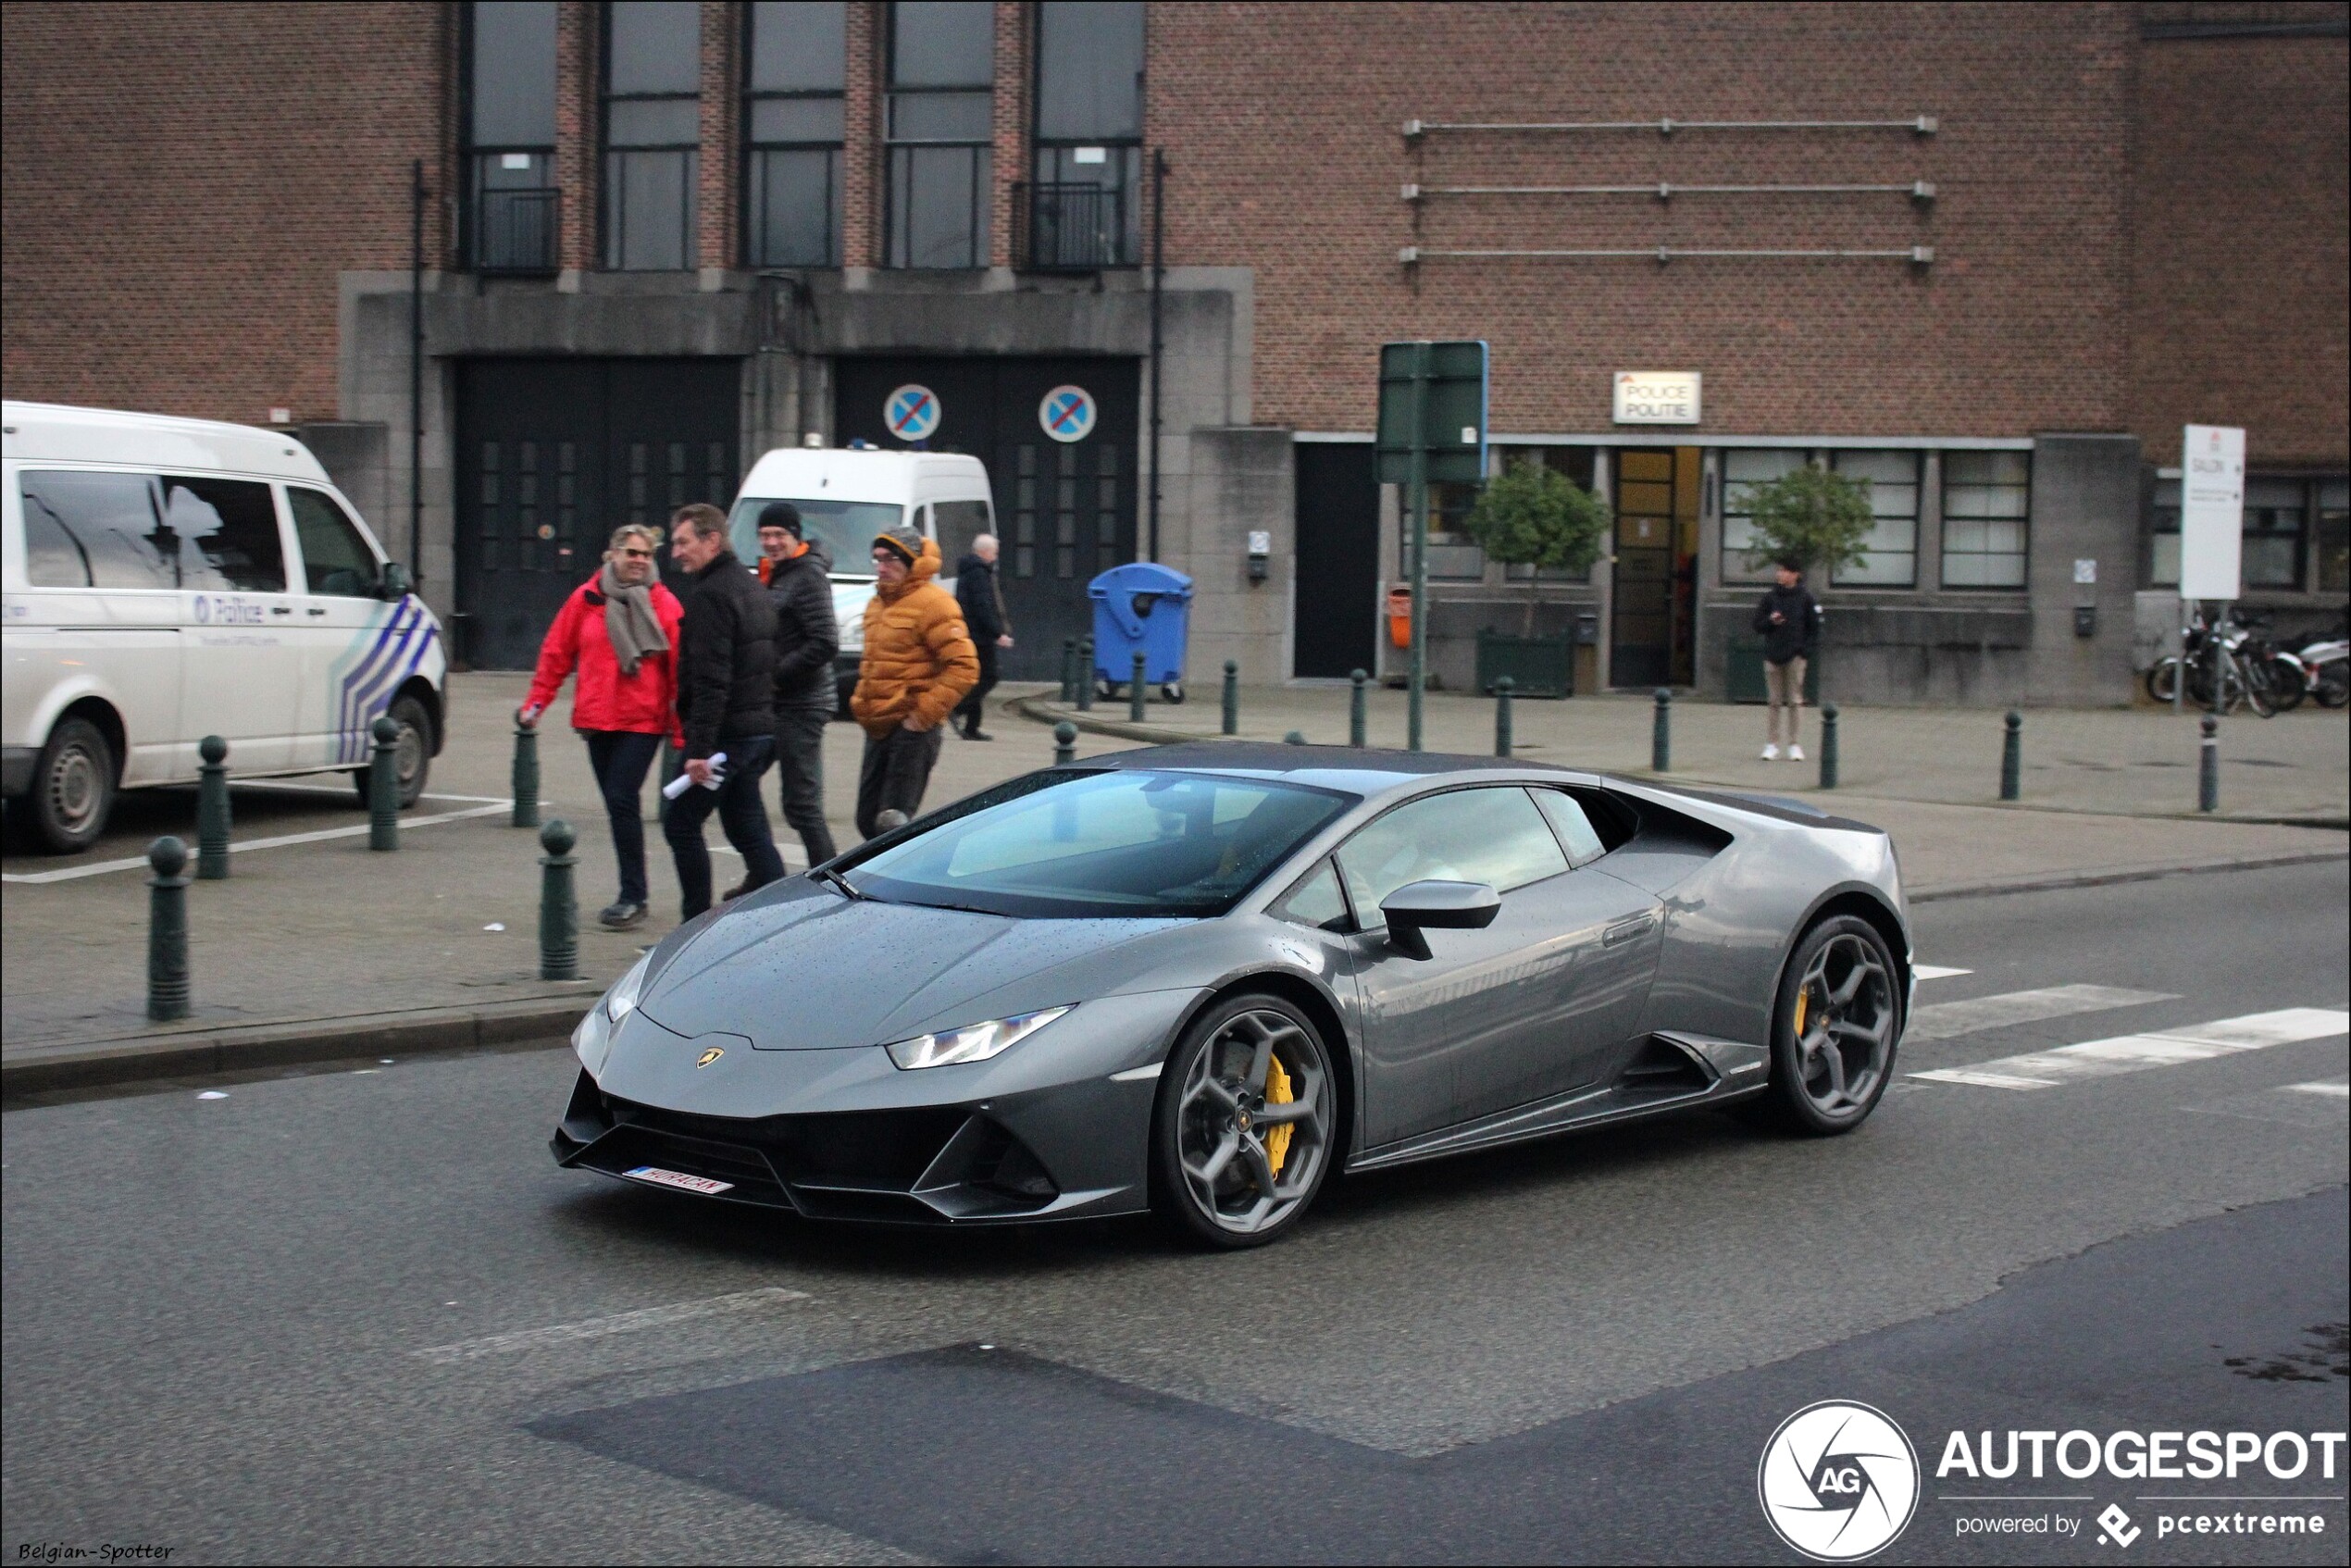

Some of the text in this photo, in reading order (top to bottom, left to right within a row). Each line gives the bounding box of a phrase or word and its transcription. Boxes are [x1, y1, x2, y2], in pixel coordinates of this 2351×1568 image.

[1626, 385, 1688, 399] POLICE
[1625, 403, 1688, 417] POLITIE
[644, 1169, 722, 1189] HURACAN
